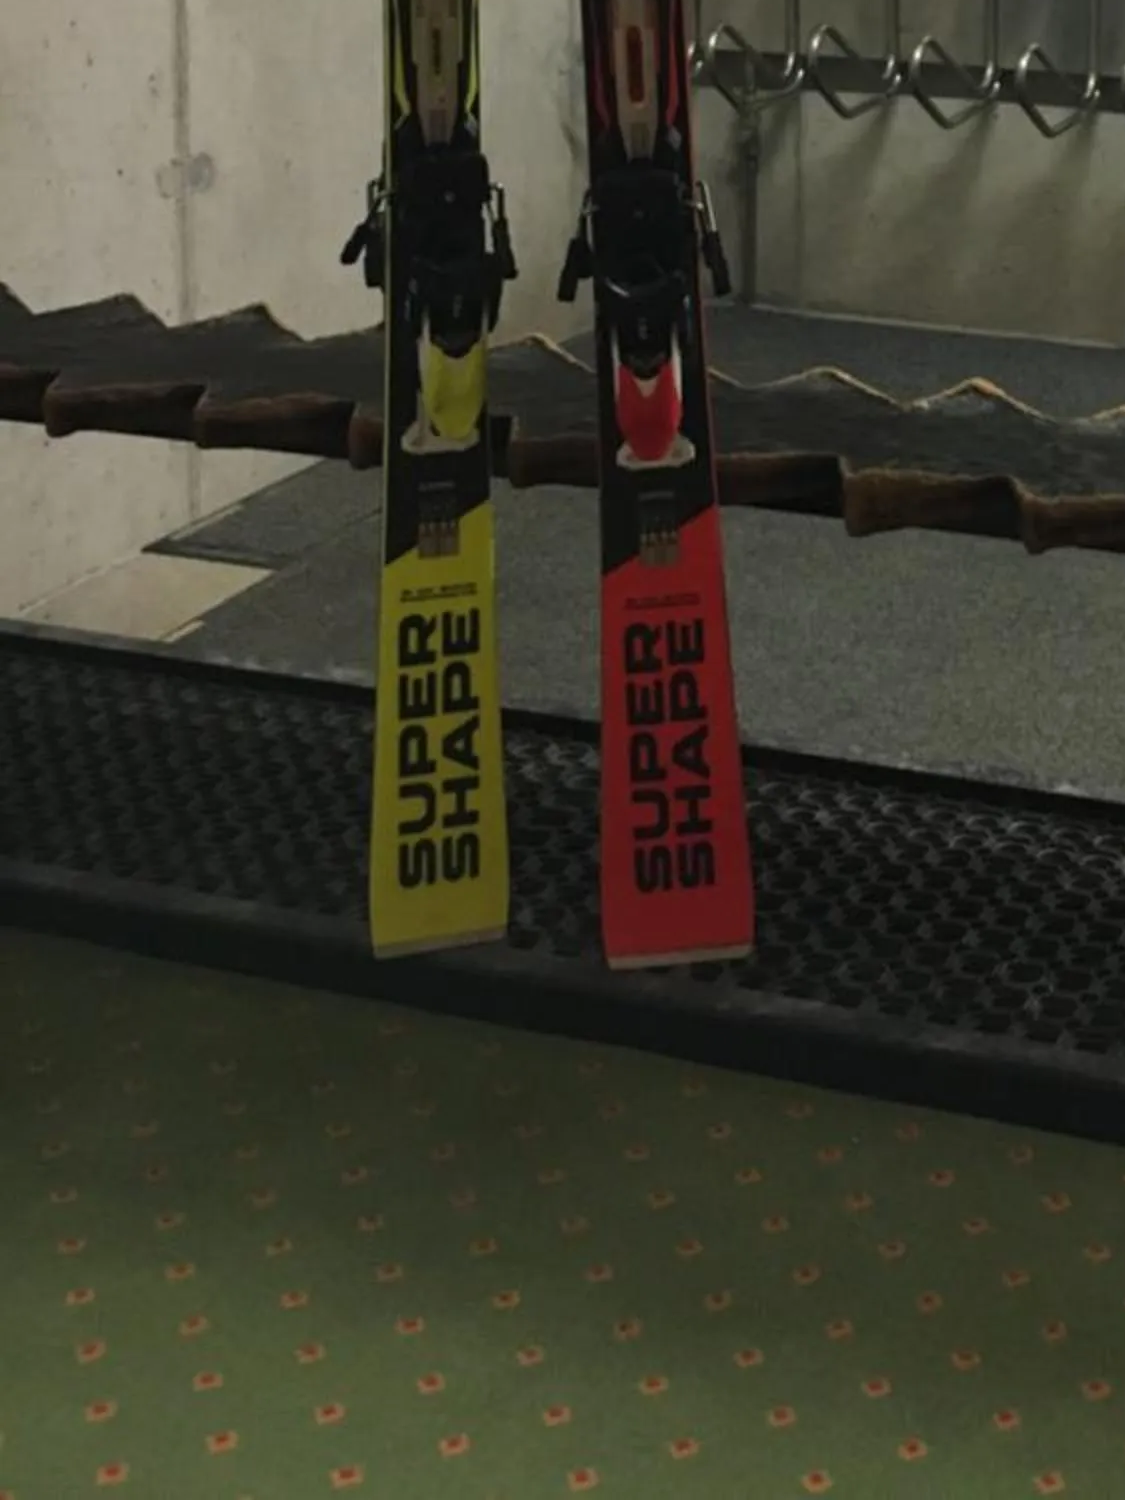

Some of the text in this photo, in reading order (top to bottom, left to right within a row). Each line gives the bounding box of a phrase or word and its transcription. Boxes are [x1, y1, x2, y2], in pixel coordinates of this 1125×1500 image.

[398, 612, 436, 889] SUPER
[441, 607, 480, 882] SHAPE
[627, 622, 672, 893] SUPER
[668, 617, 715, 888] SHAPE
